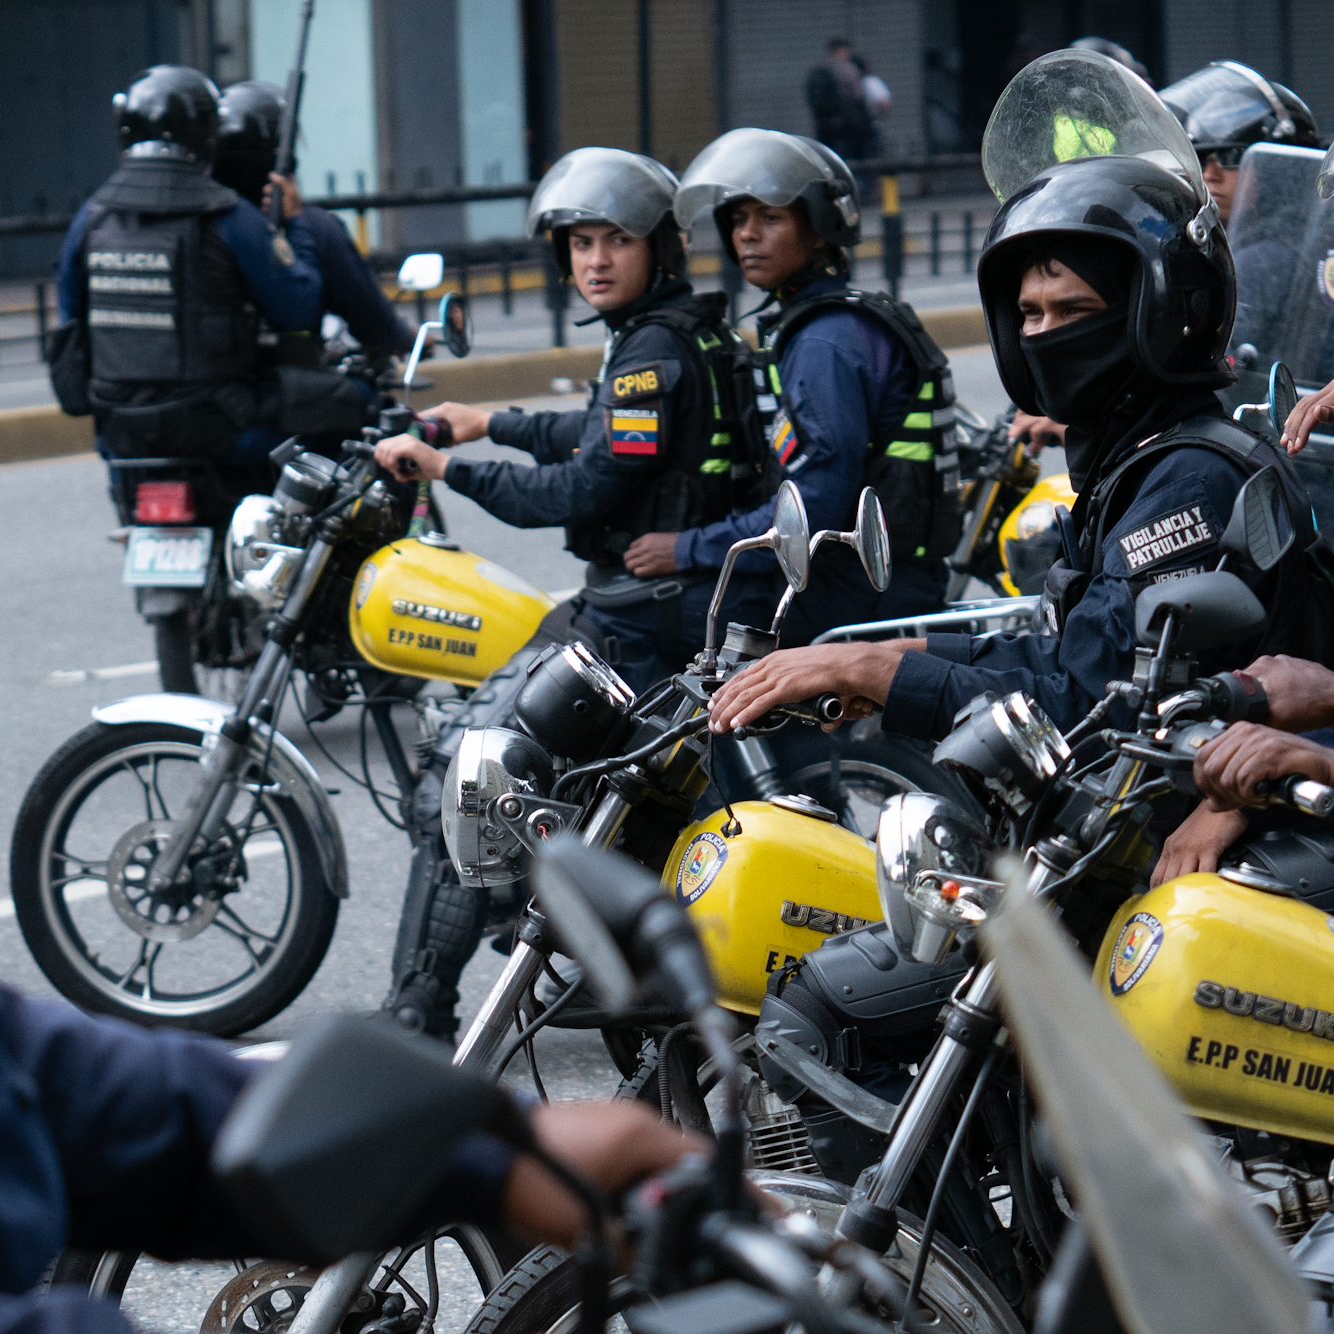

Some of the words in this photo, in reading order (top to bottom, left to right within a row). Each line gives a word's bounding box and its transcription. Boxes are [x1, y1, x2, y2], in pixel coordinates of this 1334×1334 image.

[88, 251, 172, 271] POLICIA
[613, 370, 659, 397] CPNB
[611, 408, 659, 418] VENEZUELA
[1119, 510, 1195, 553] VIGILANCIA
[1191, 506, 1204, 523] Y
[1126, 521, 1212, 570] PATRULLAJE
[391, 598, 483, 633] SUZUKI
[417, 632, 443, 652] SAN
[444, 637, 478, 658] JUAN
[676, 842, 694, 888] NACIONAL
[689, 859, 723, 902] BOLIVARIANA
[1122, 943, 1160, 992] BOLIVARIANA
[1185, 1035, 1240, 1070] E.P.P
[1241, 1049, 1292, 1084] SAN
